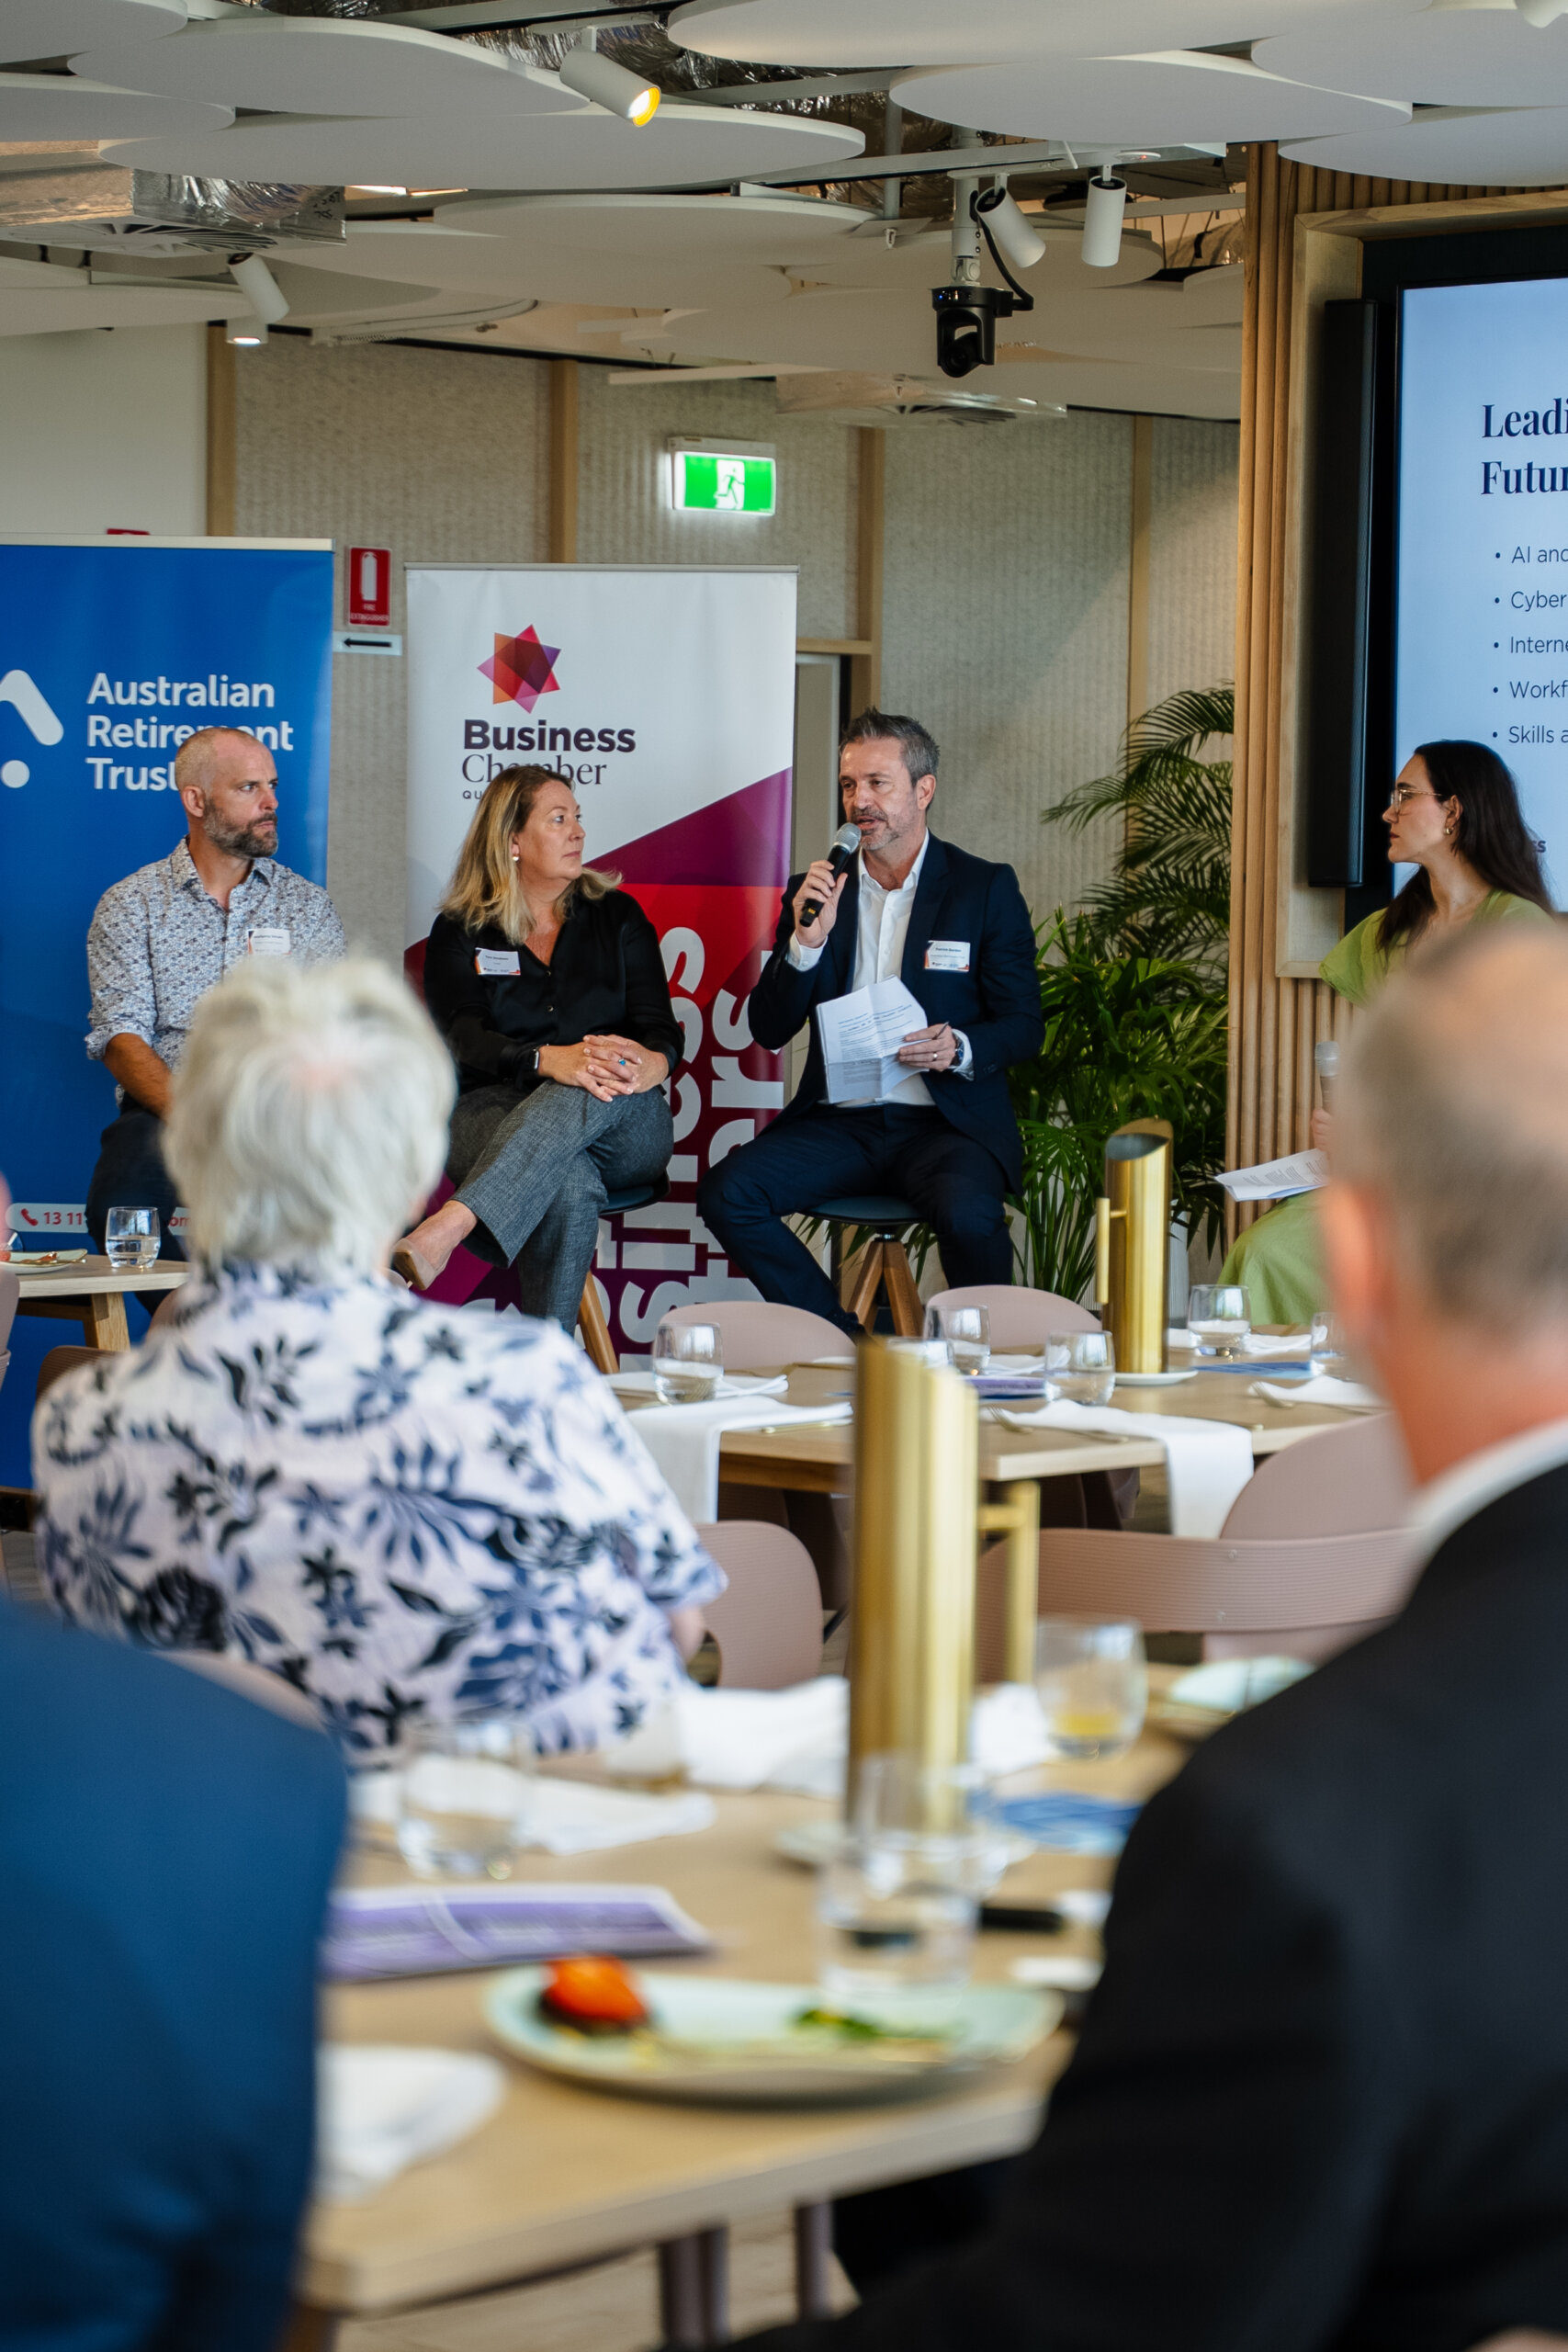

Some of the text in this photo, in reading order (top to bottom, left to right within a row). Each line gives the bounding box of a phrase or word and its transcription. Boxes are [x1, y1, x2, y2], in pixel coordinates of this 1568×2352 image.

[1511, 546, 1530, 563] AI
[1511, 590, 1567, 612] Cyber
[87, 672, 275, 707] Australian
[87, 715, 294, 751] Retirent
[464, 719, 636, 752] Business
[1508, 725, 1554, 743] Skills
[462, 753, 607, 785] Chber
[44, 1212, 82, 1225] 13 11
